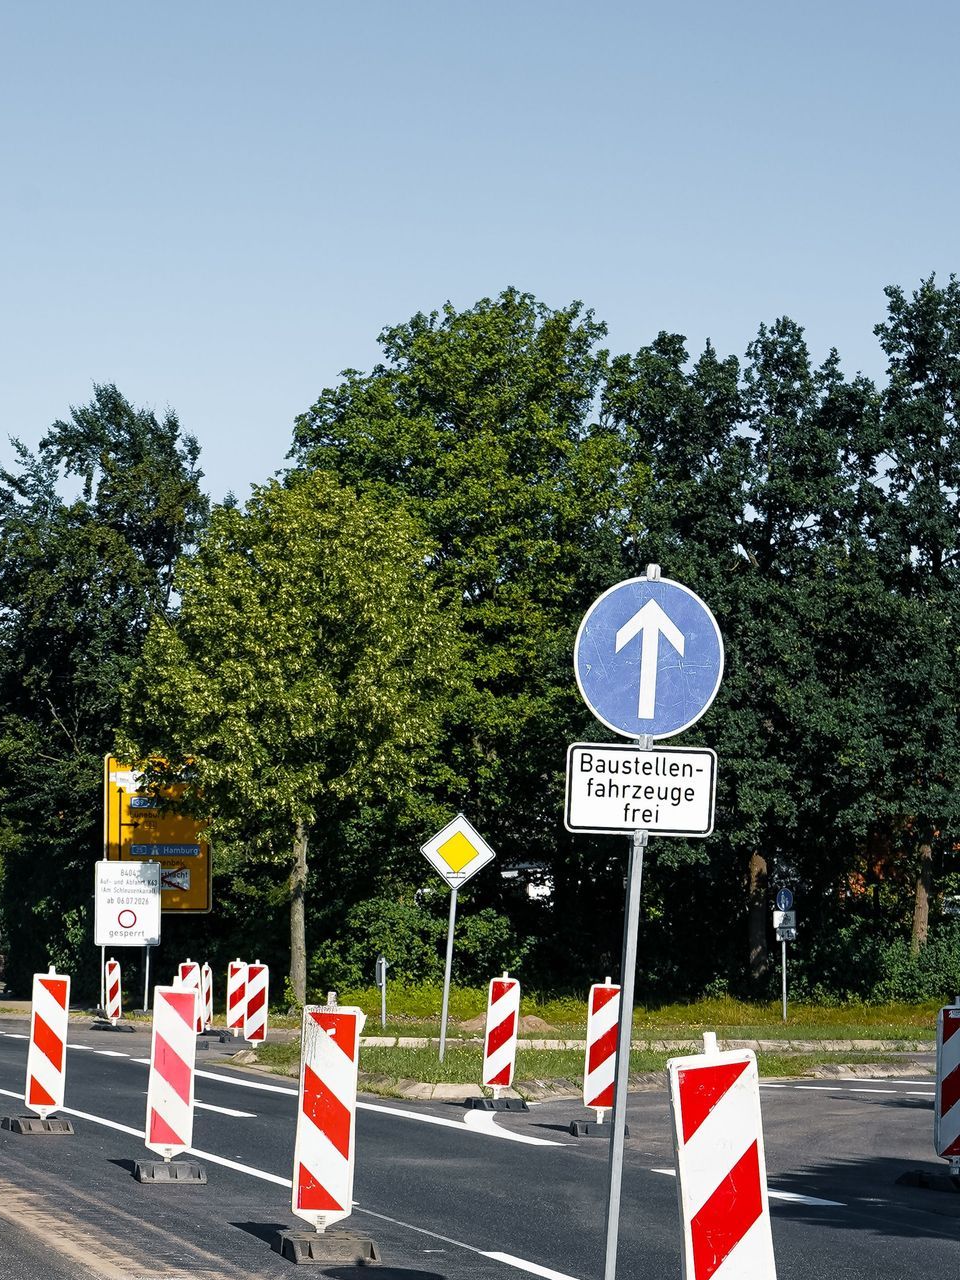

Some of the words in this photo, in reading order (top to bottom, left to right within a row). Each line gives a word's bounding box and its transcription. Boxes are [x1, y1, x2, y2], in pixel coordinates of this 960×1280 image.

[581, 753, 703, 778] Baustellen-
[587, 778, 695, 807] fahrzeuge
[624, 804, 659, 823] frei
[163, 845, 198, 854] Hamburg
[109, 930, 144, 938] gesperrt
